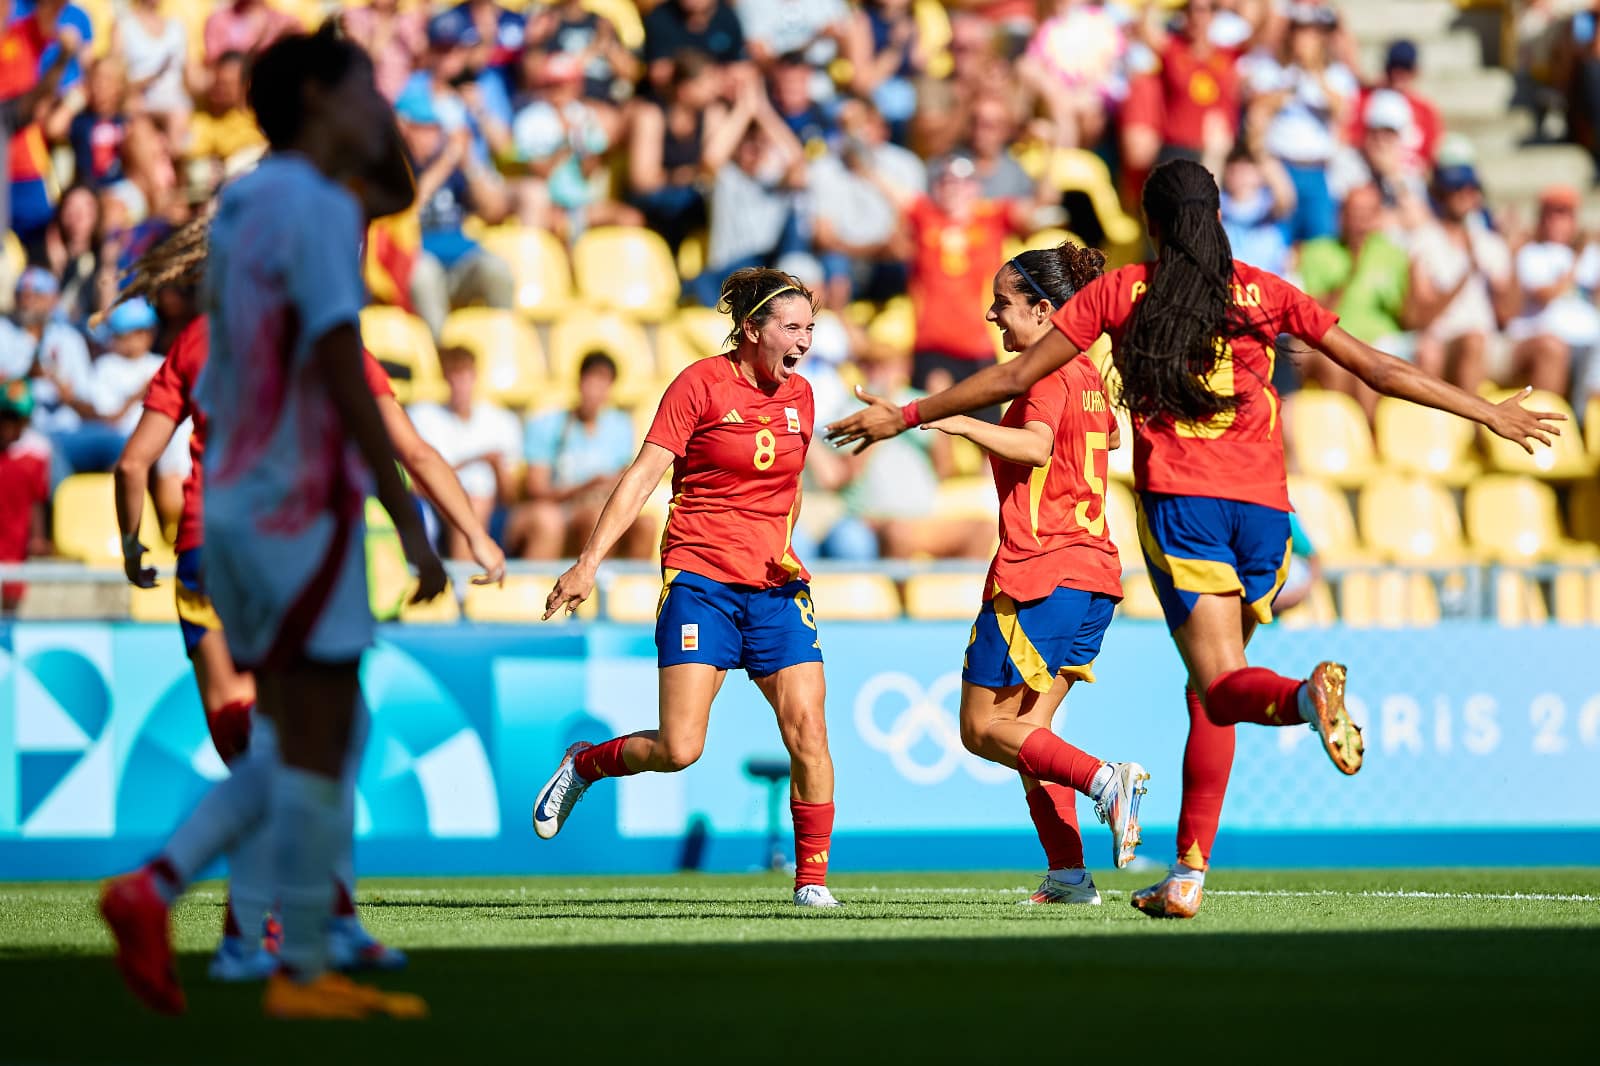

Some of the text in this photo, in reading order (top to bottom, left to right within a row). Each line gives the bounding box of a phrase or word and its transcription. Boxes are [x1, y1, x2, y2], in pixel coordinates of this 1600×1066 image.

[753, 428, 776, 471] 8
[1074, 431, 1107, 537] 5
[794, 590, 816, 631] 8
